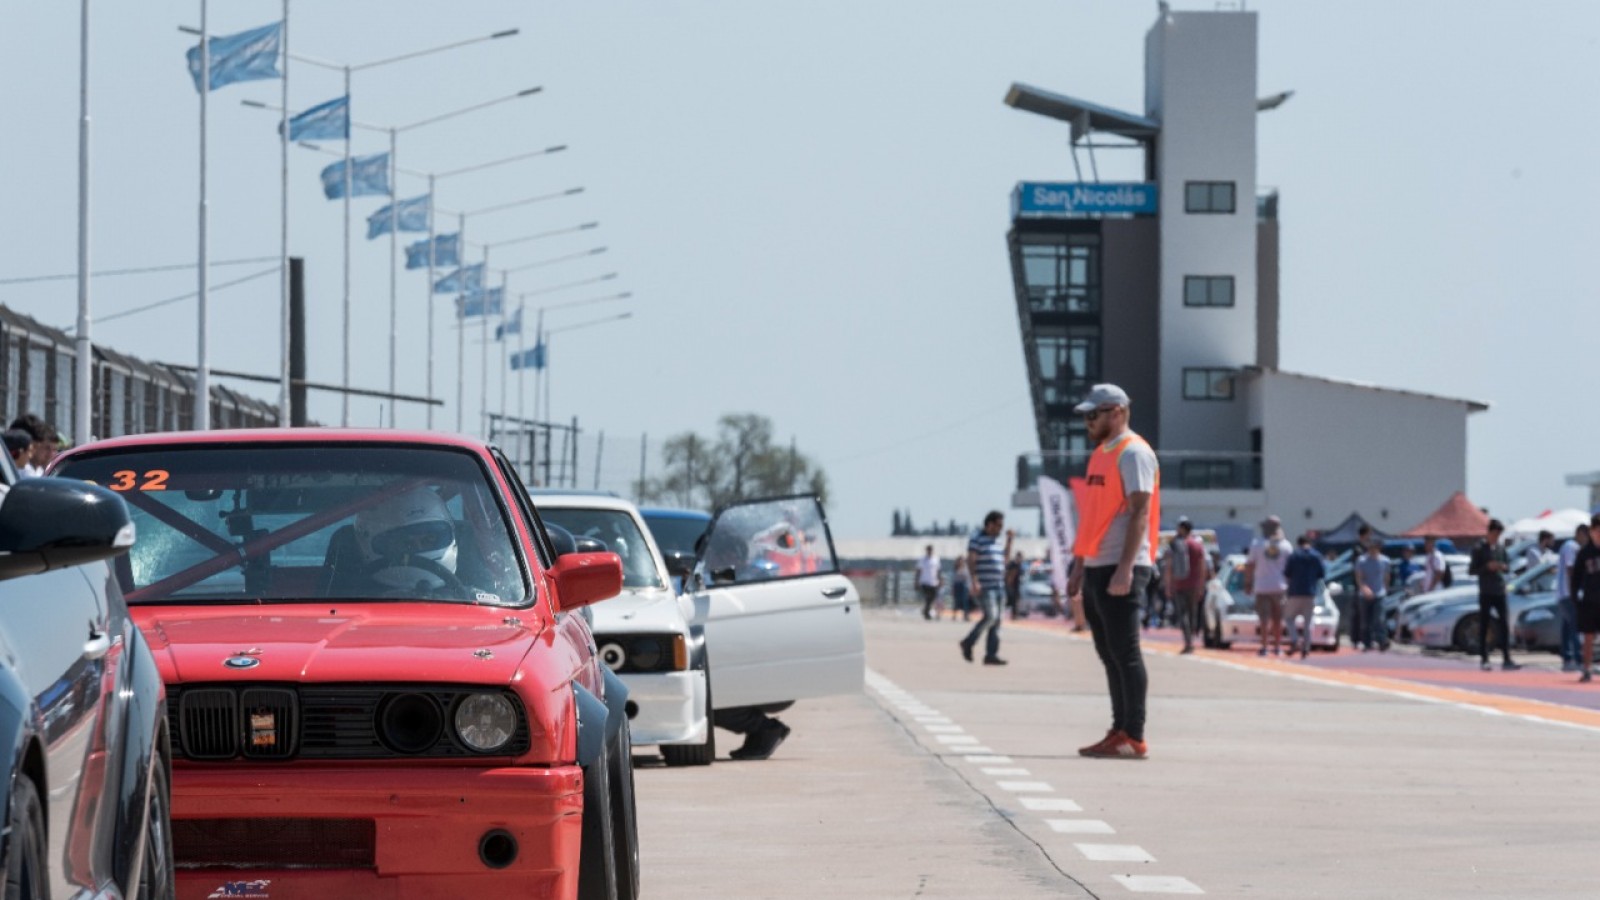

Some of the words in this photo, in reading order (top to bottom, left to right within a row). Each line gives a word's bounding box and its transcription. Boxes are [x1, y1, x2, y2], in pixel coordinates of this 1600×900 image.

[1033, 186, 1071, 206] San
[1074, 186, 1146, 206] Nicolás
[109, 470, 170, 491] 32
